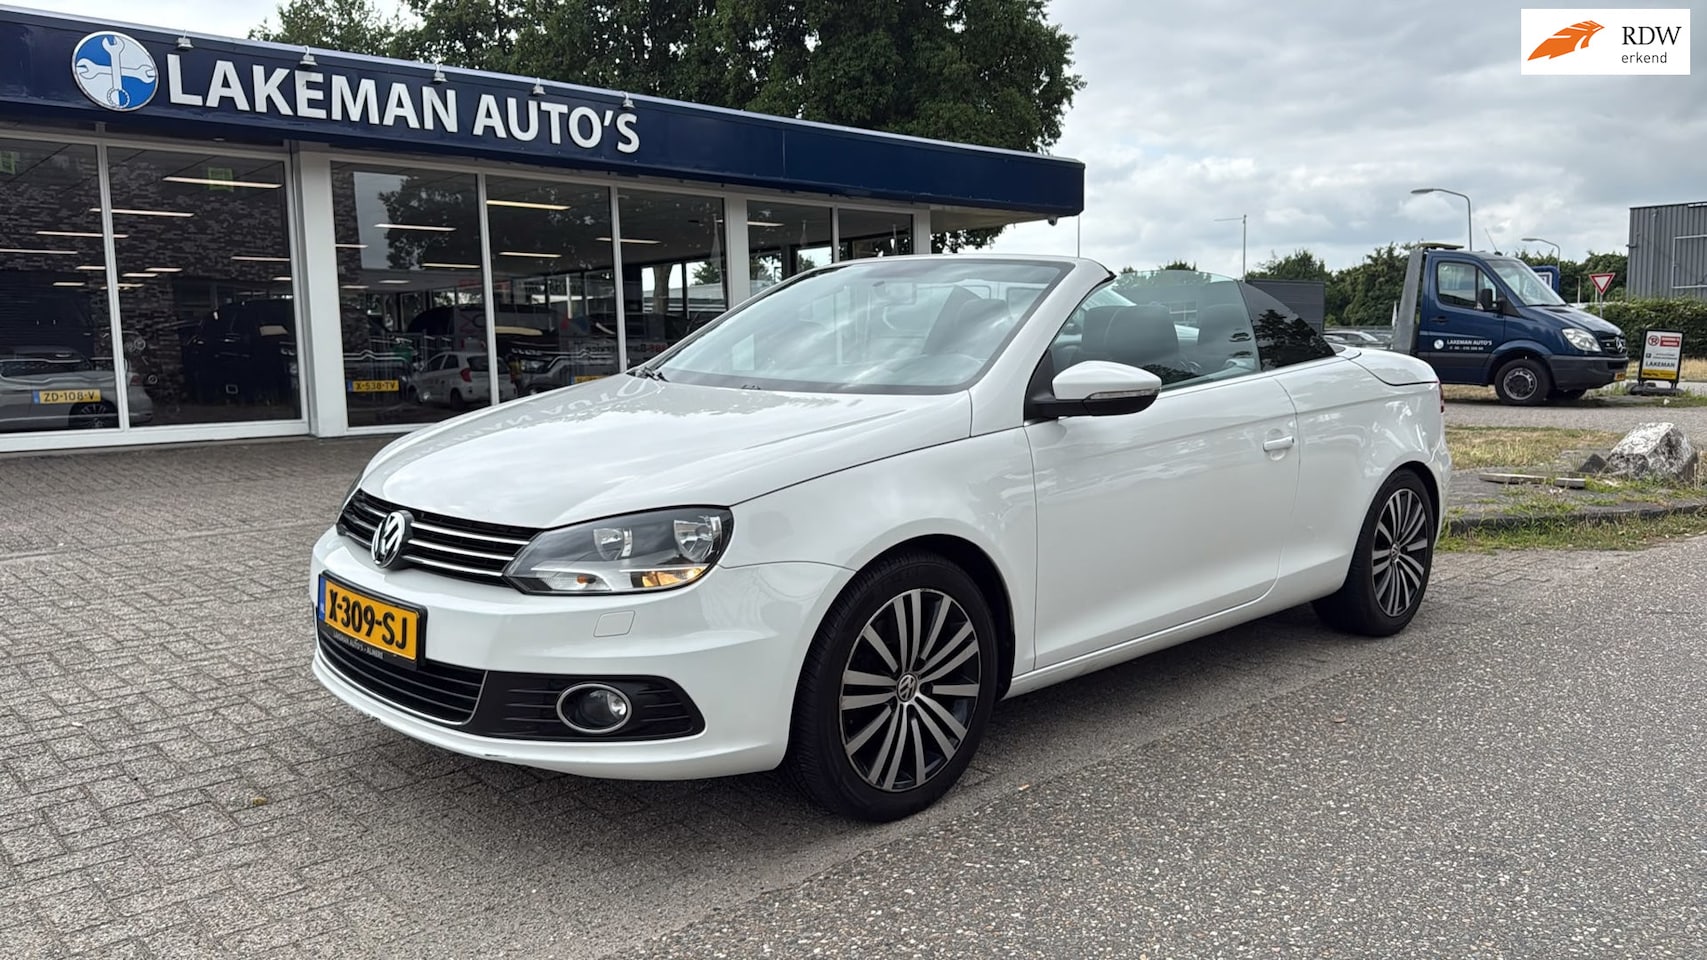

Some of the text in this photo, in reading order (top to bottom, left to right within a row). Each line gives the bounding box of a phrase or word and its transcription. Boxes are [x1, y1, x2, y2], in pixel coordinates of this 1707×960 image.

[167, 53, 640, 154] LAKEMAN AUTO'S
[1645, 360, 1676, 368] LAKEMAN
[43, 391, 96, 402] ZD-108-V
[328, 589, 408, 650] X-309-SJ
